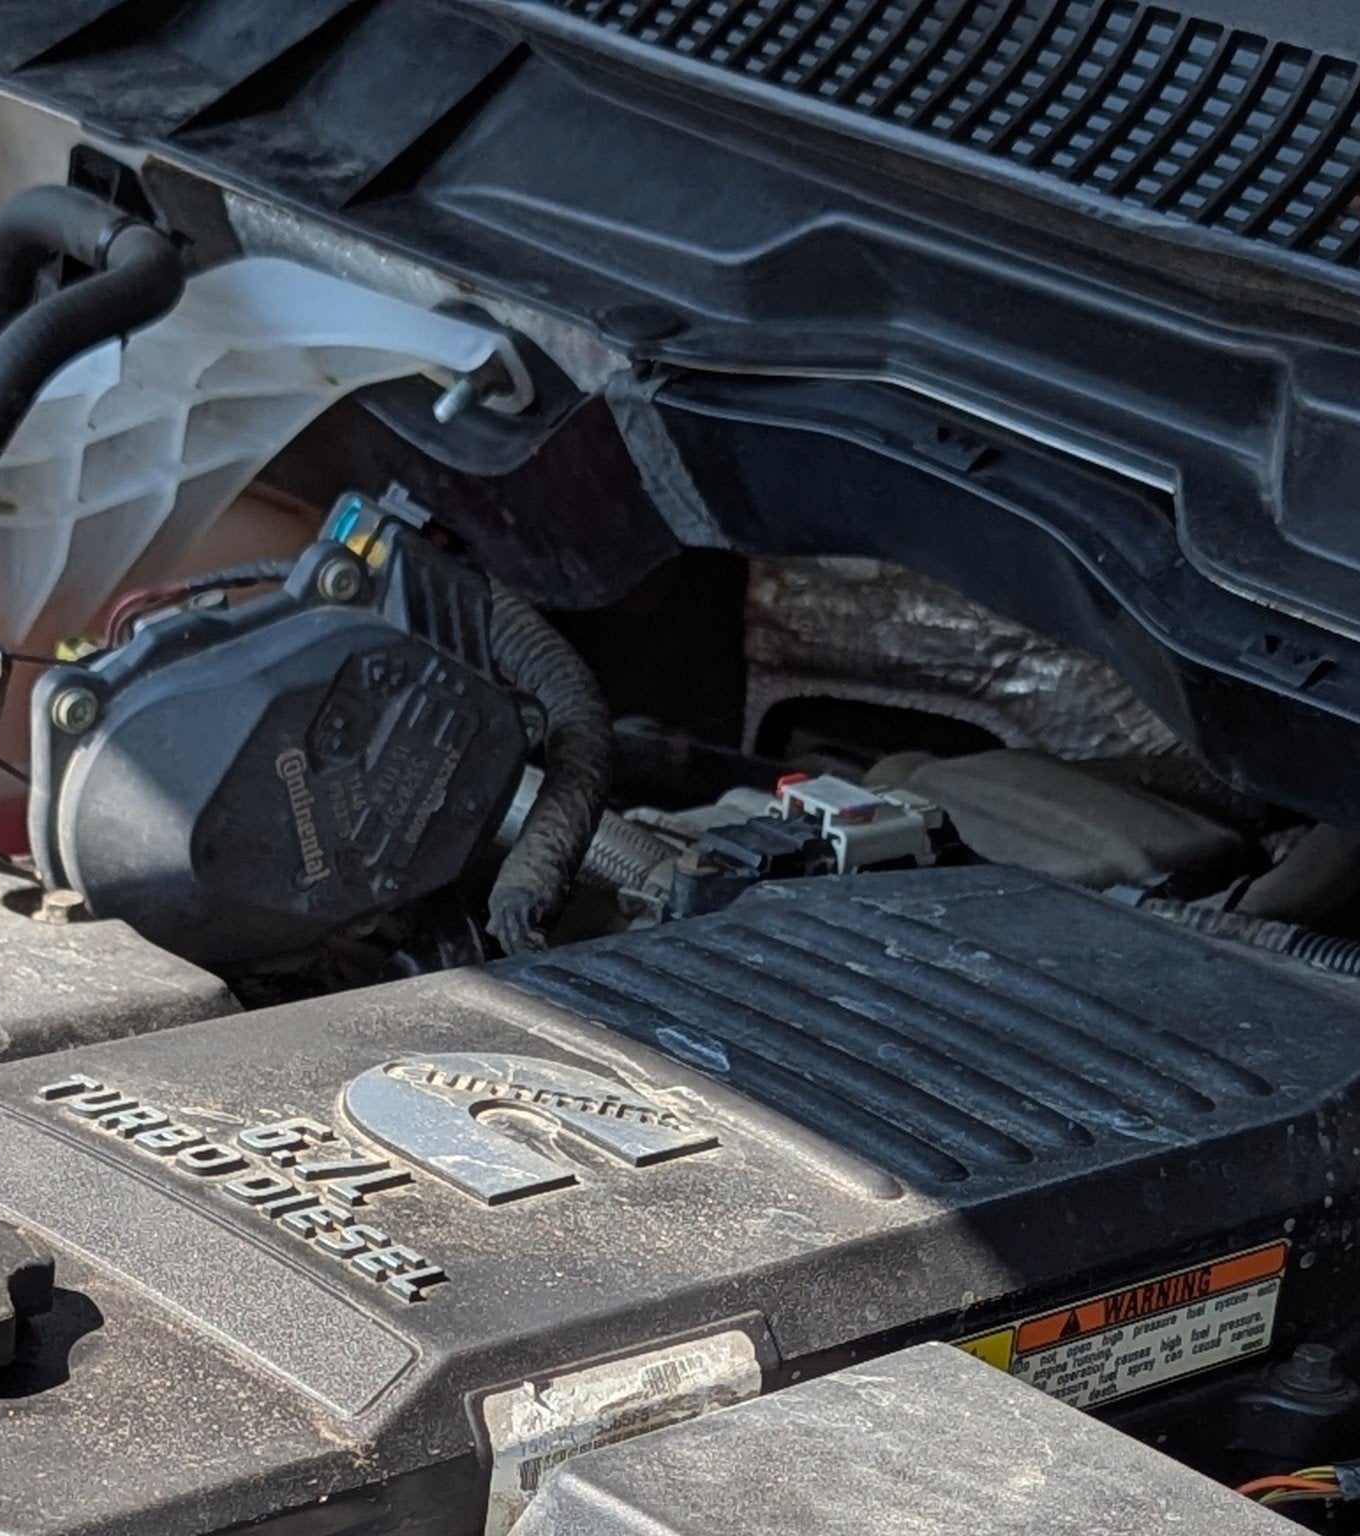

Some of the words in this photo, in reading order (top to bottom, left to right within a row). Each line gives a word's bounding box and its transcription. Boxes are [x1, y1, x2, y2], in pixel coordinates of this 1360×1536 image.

[275, 747, 333, 885] Continental
[40, 1073, 244, 1176] TURBO
[222, 1175, 452, 1303] DIESEL
[238, 1117, 414, 1205] 6.7L
[1102, 1331, 1124, 1347] high
[1133, 1315, 1178, 1339] pressure
[1186, 1303, 1206, 1320] fuel
[1103, 1268, 1213, 1324] WARNING
[1057, 1362, 1105, 1385] operation
[1160, 1335, 1182, 1353] high
[1191, 1324, 1211, 1341] fuel
[1218, 1312, 1263, 1336] pressure.
[1127, 1358, 1156, 1377] spray
